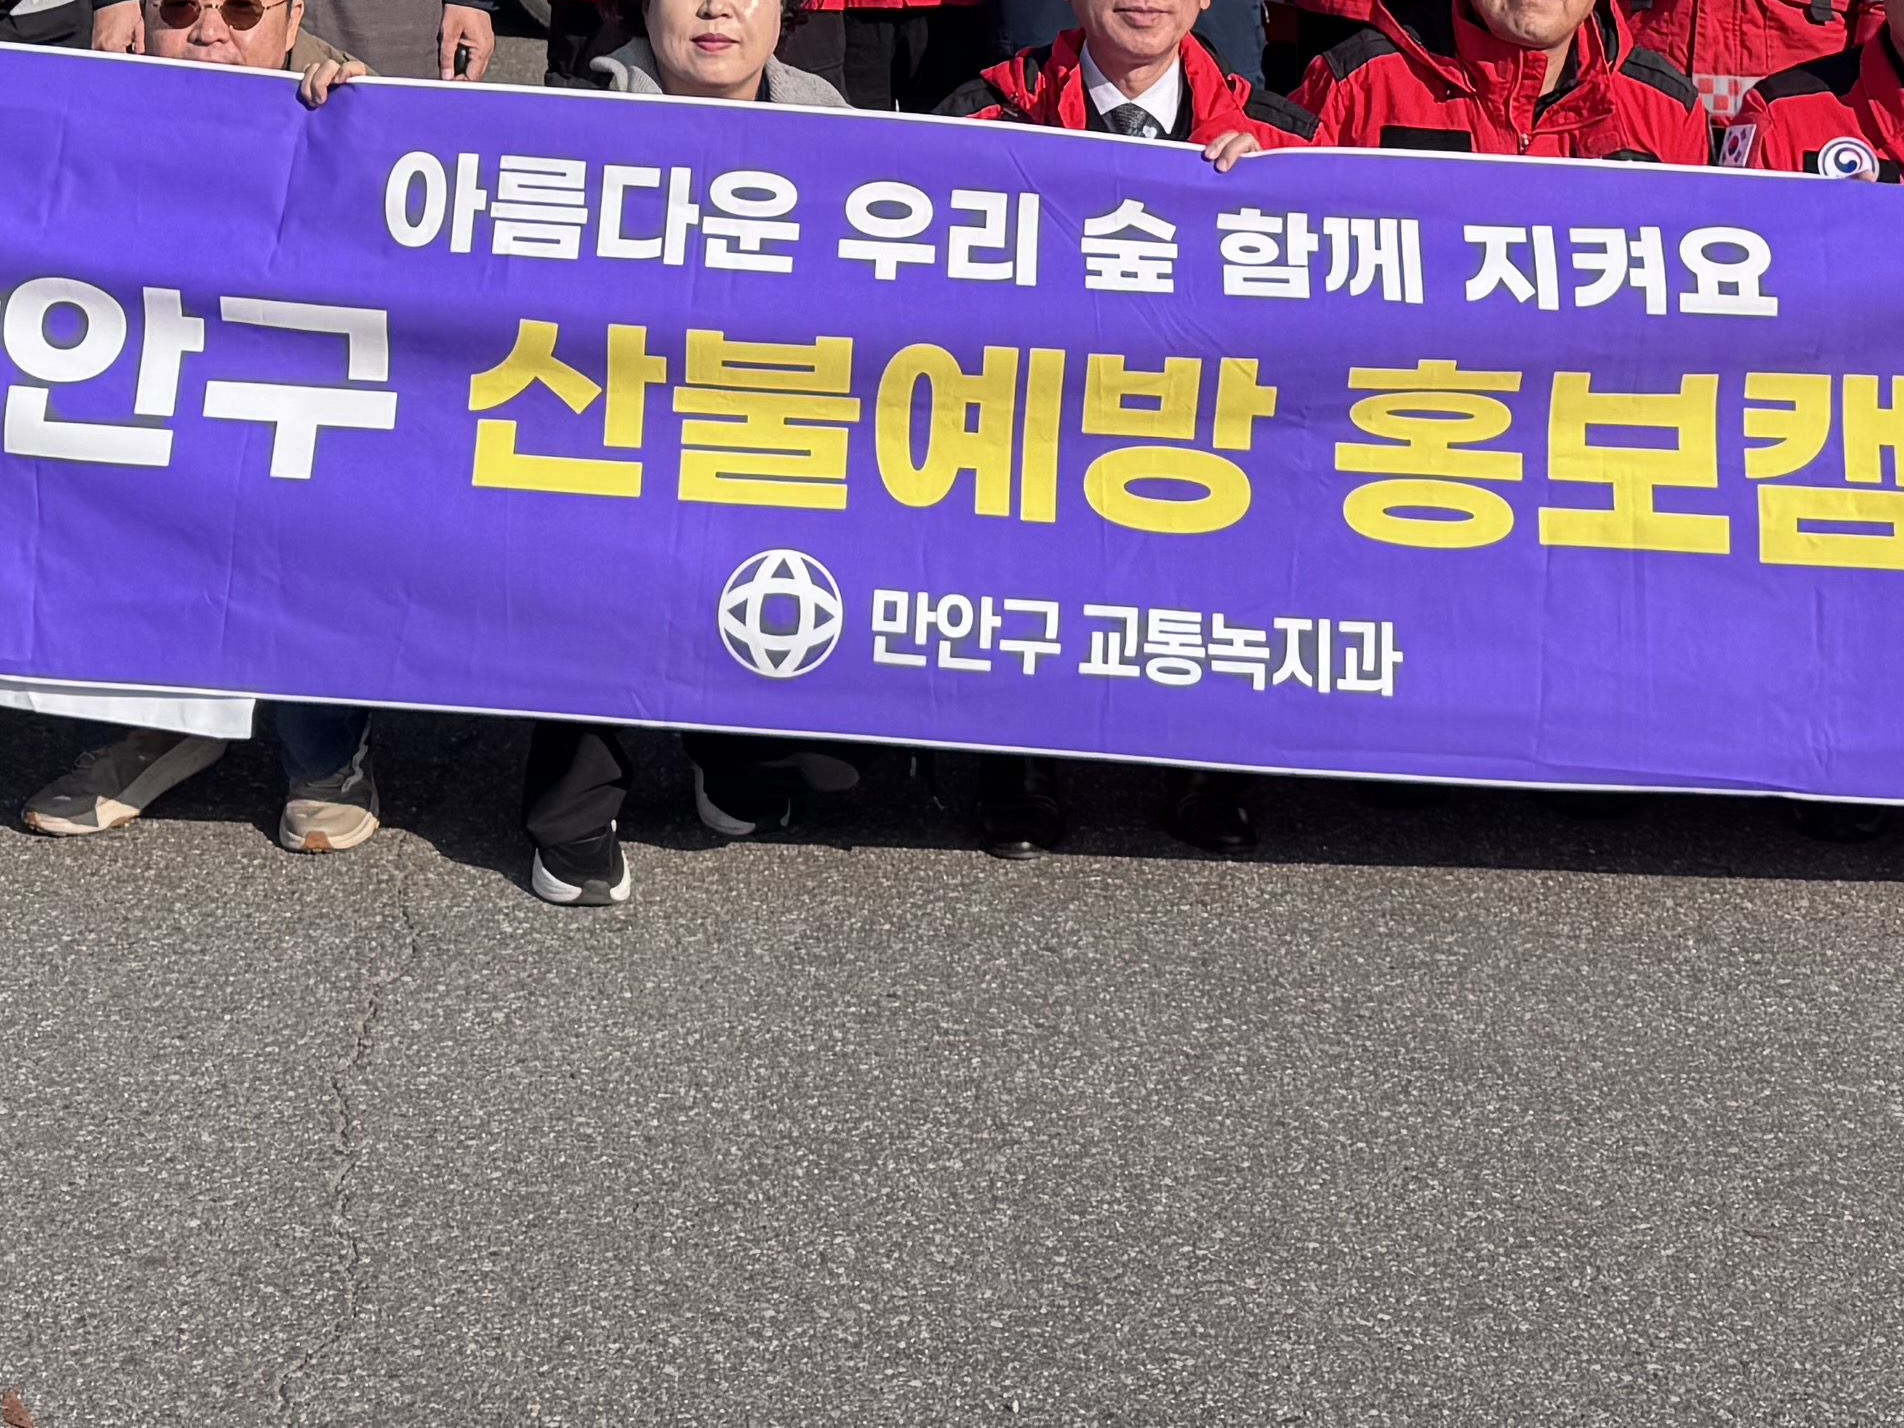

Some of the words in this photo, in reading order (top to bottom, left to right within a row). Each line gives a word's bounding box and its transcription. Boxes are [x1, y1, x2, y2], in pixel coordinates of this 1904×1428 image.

[384, 150, 801, 275] 아름다운
[837, 180, 1041, 288] 우리
[1080, 197, 1179, 294] 숲
[1216, 206, 1424, 305] 함께
[1462, 223, 1780, 318] 지켜요
[467, 318, 1278, 535] 산불예방
[871, 588, 1062, 677] 만안구
[1077, 604, 1405, 697] 교통녹지과
